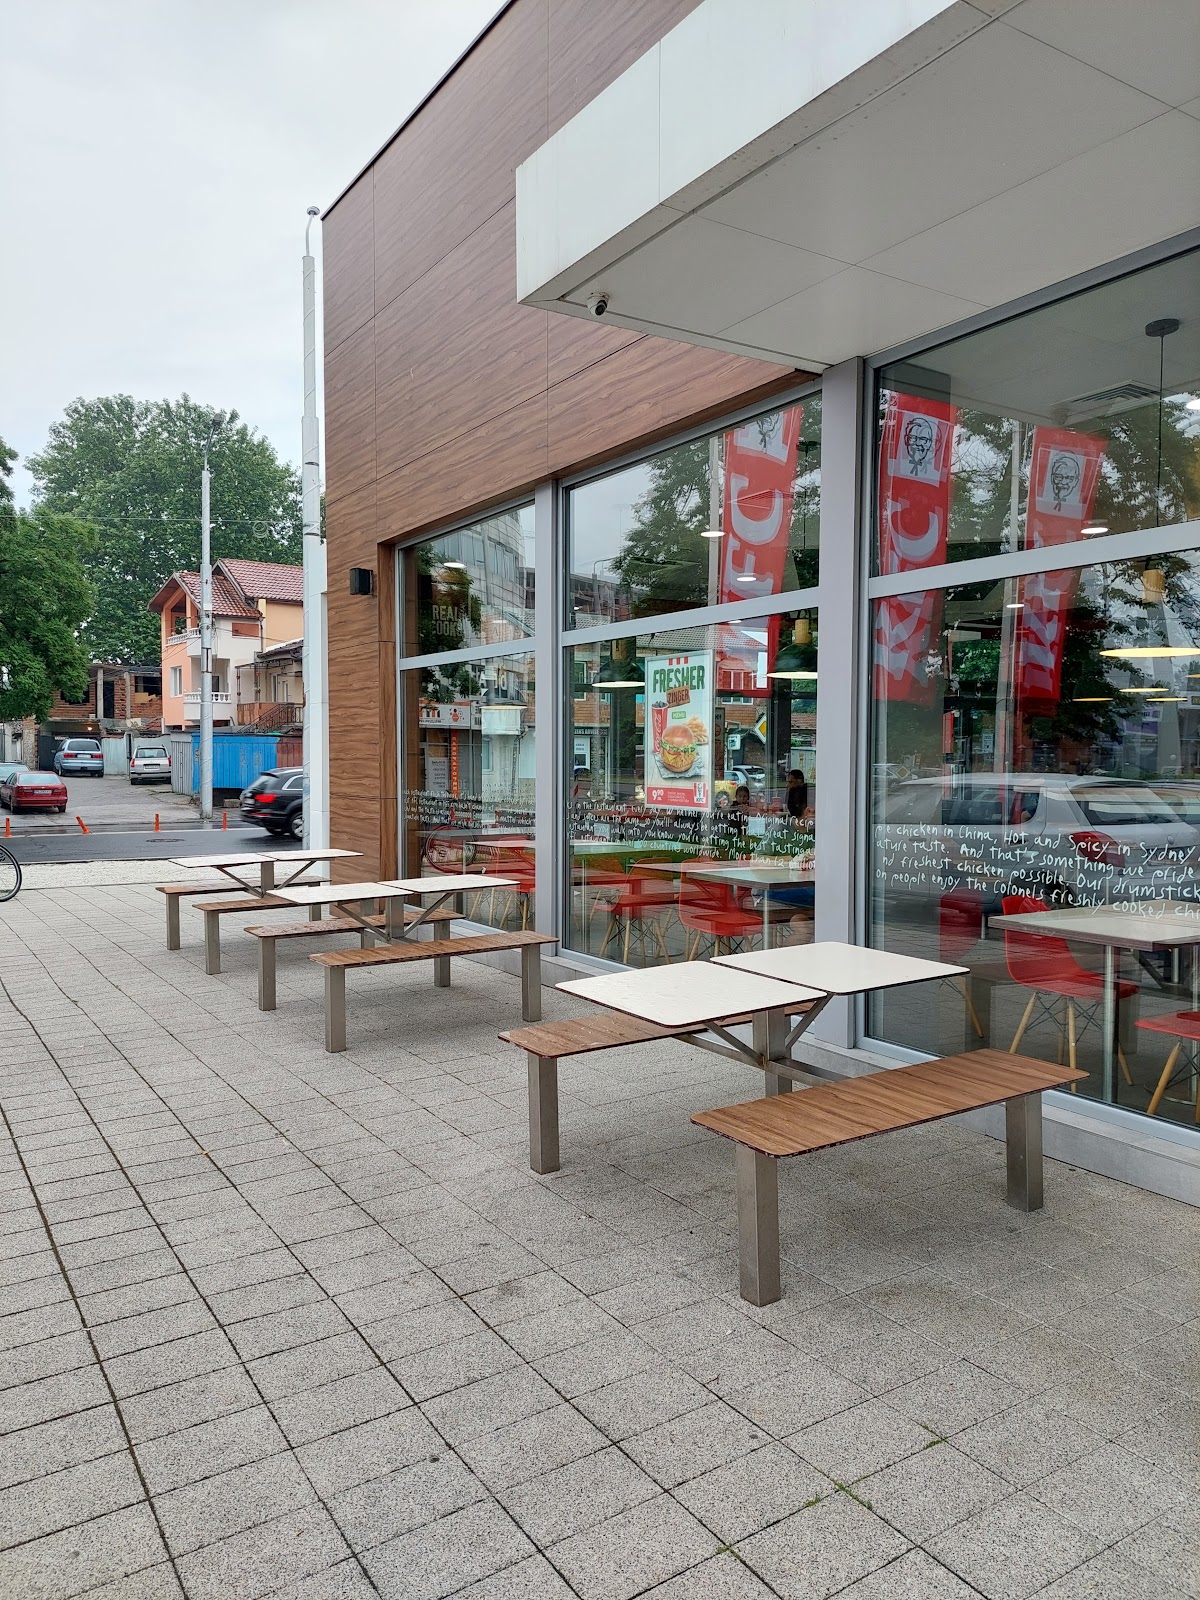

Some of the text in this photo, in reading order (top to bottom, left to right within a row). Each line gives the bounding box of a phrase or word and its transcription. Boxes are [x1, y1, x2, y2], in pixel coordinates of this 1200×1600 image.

[432, 605, 458, 621] REAL
[653, 665, 705, 693] FRESHER
[667, 688, 690, 705] ZINGER
[729, 848, 747, 861] More
[732, 836, 746, 848] the
[749, 839, 768, 851] best
[896, 821, 938, 837] chicken
[943, 824, 954, 837] in
[958, 825, 998, 844] China,
[1034, 833, 1061, 849] and
[1068, 834, 1110, 859] Spicy
[1117, 840, 1131, 857] in
[1139, 841, 1196, 865] Sydney
[876, 838, 1195, 886] ature taste. And that's something we pride
[882, 852, 1200, 901] nd freshest chicken possible. Our drumstick
[876, 868, 887, 881] on
[891, 872, 926, 890] people
[932, 873, 961, 893] enjoy
[966, 876, 988, 892] the
[1050, 889, 1106, 915] freshly
[1112, 901, 1166, 920] cooked
